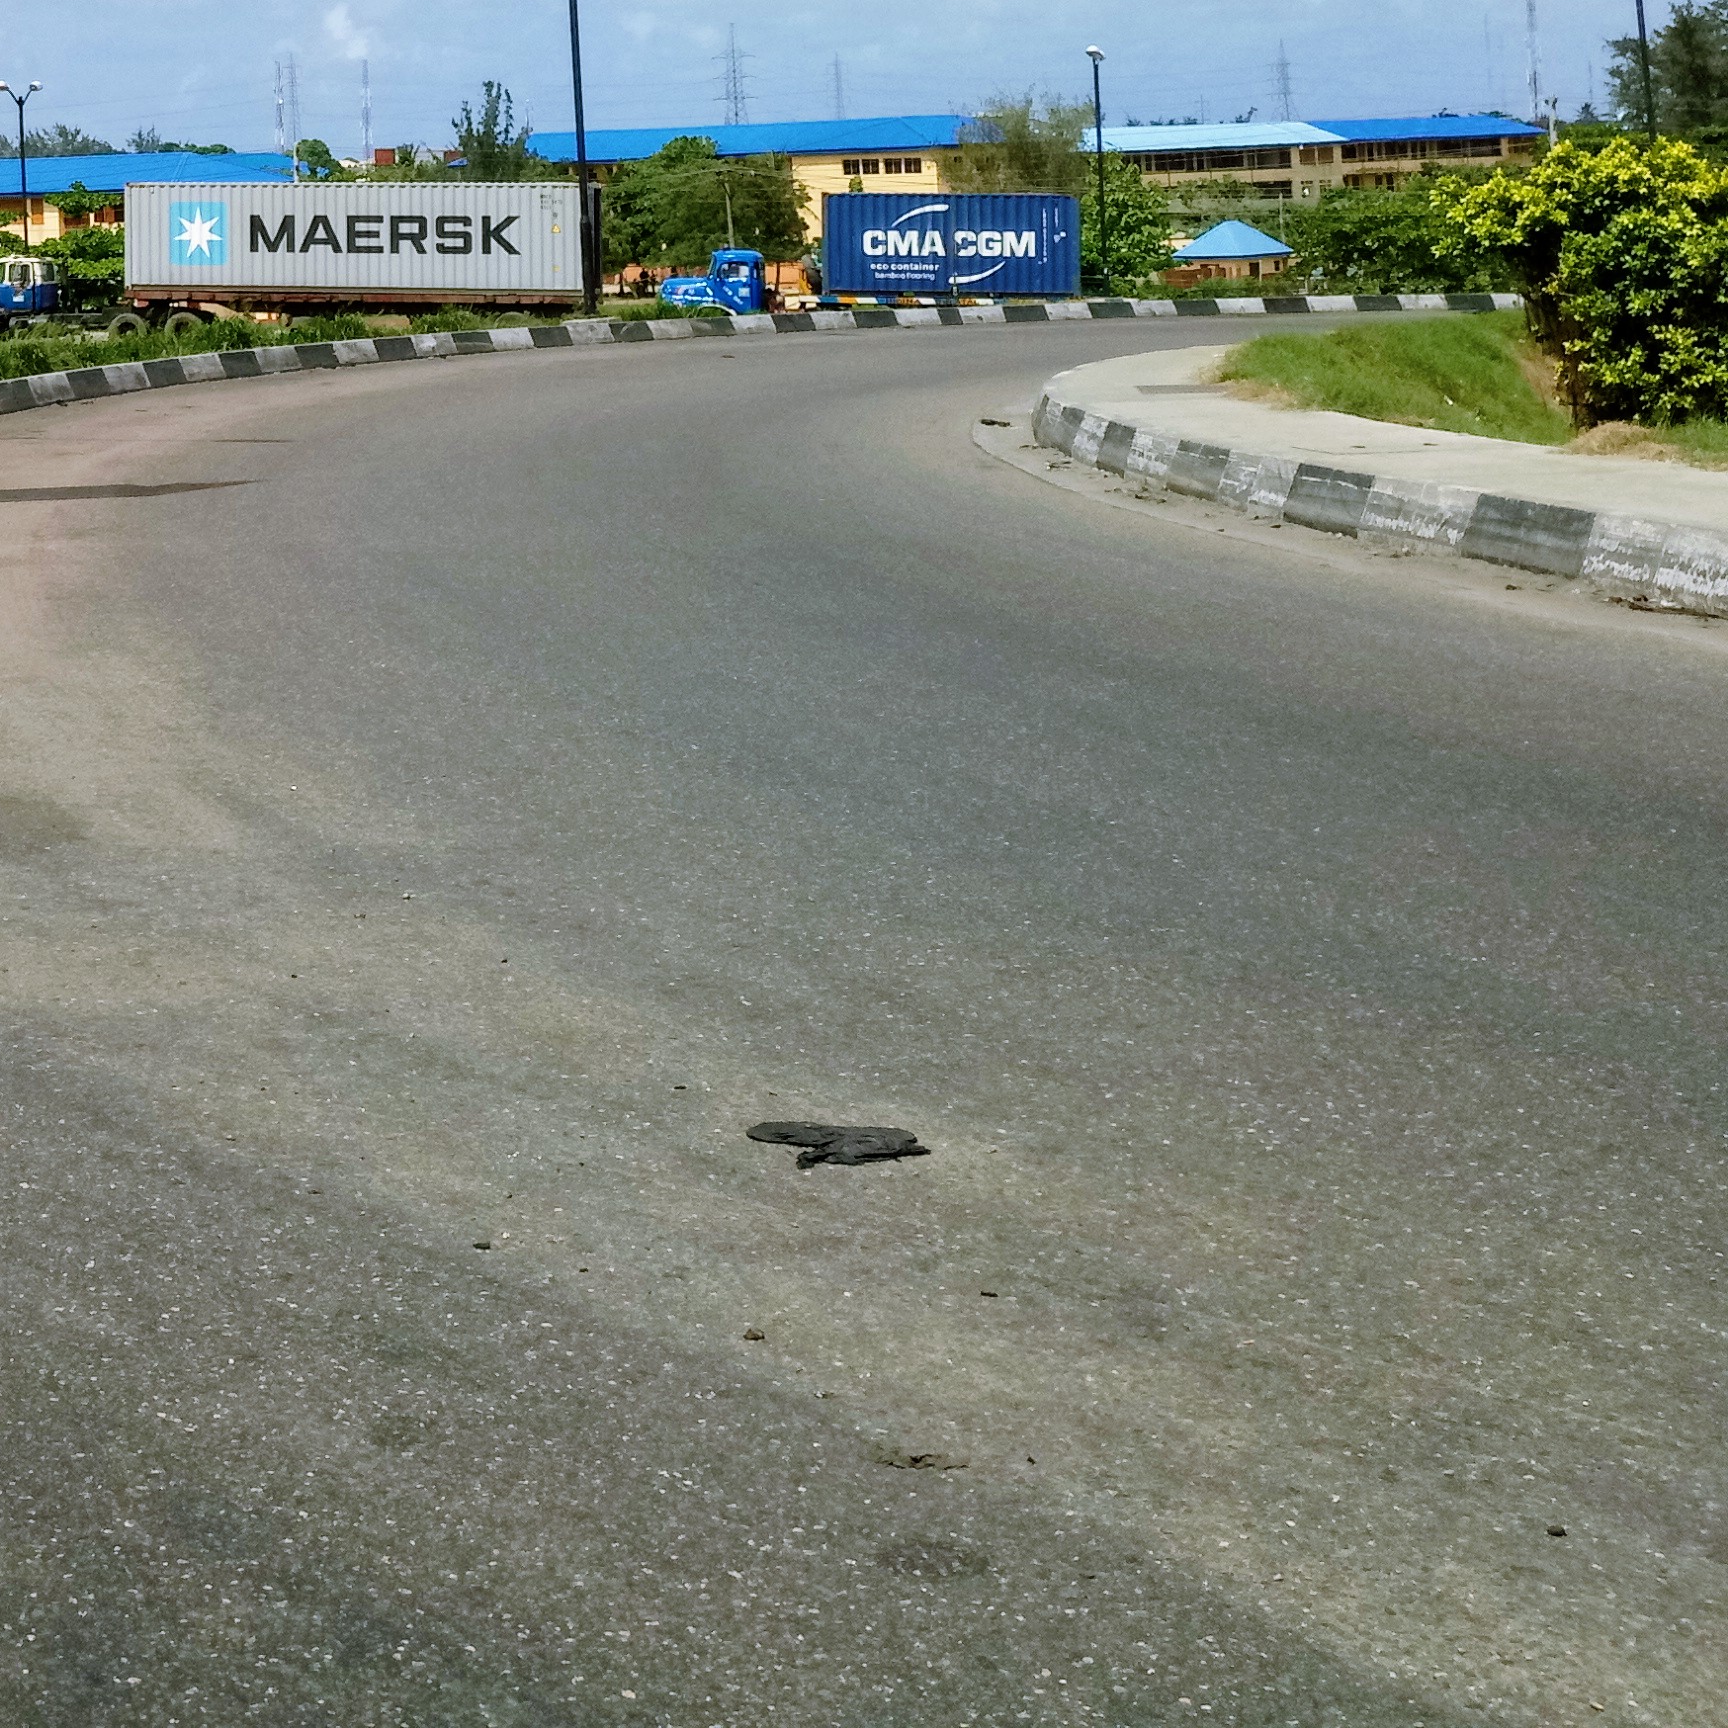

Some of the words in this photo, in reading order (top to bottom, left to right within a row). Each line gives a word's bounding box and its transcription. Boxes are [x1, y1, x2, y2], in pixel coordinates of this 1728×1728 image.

[250, 215, 521, 255] MAERSK
[862, 230, 946, 257] CMA
[954, 230, 1036, 258] CGM
[870, 263, 889, 271] eco
[890, 262, 940, 271] container
